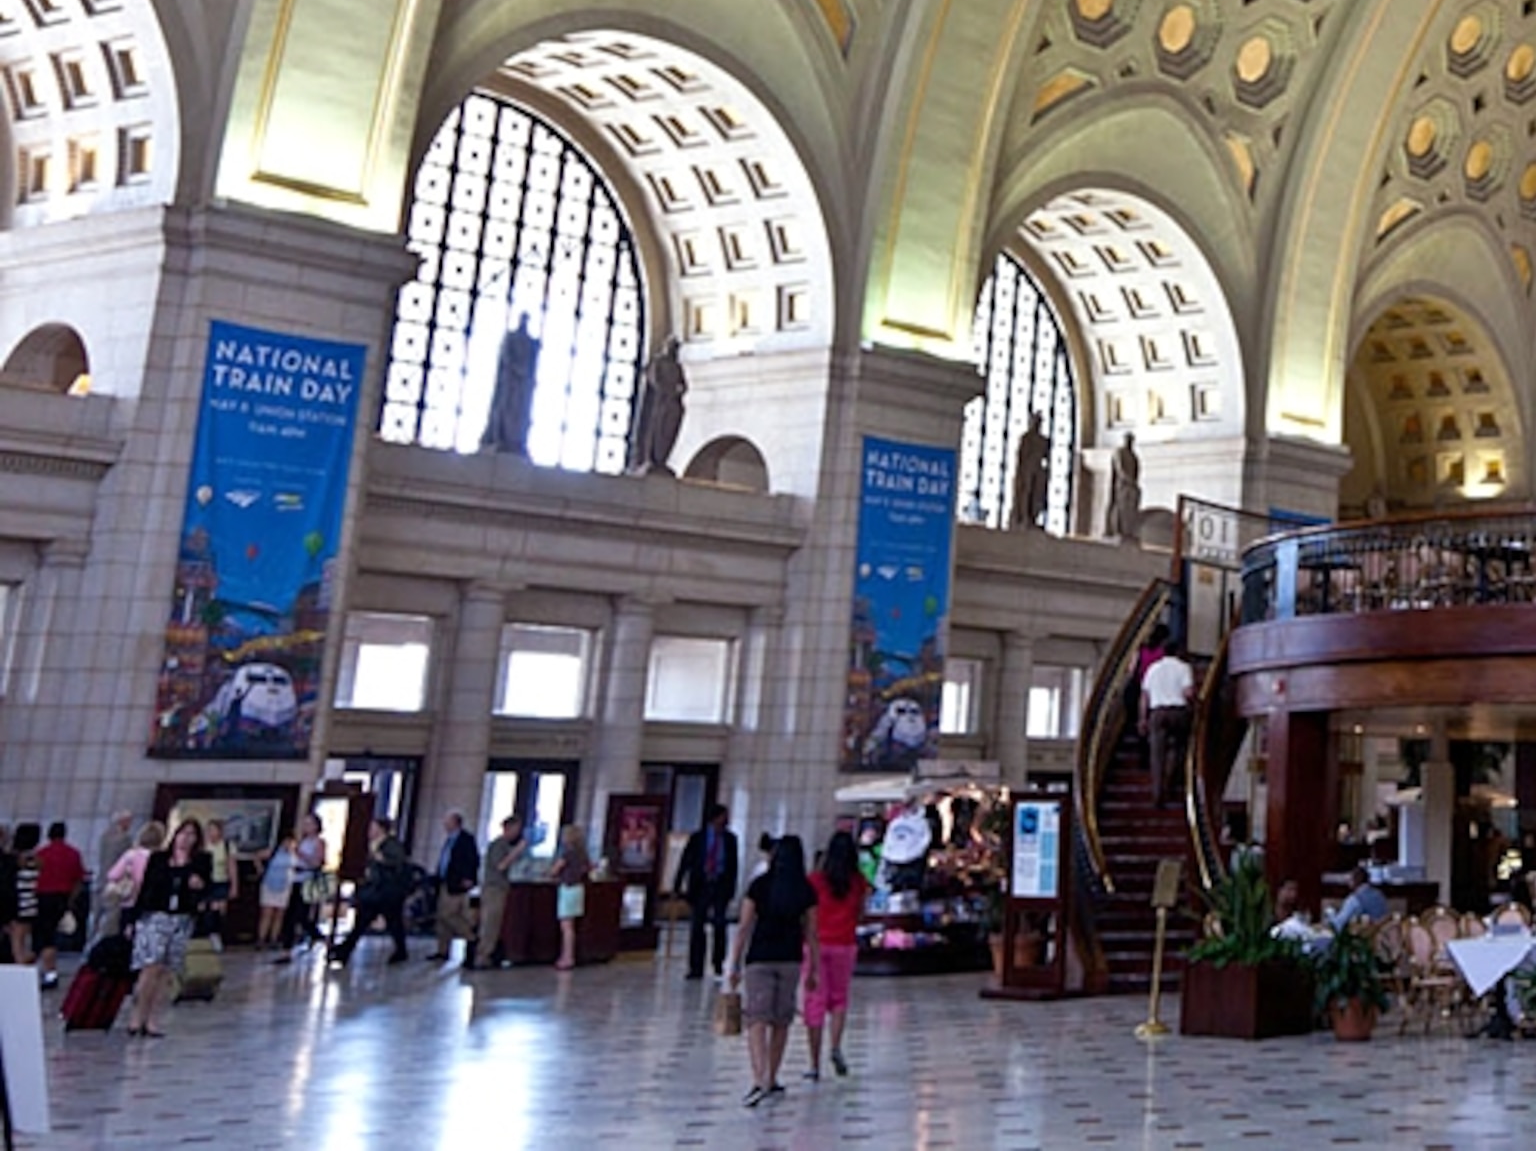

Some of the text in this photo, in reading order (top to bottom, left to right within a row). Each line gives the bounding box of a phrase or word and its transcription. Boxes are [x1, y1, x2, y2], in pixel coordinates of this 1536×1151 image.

[215, 340, 353, 380] NATIONAL
[213, 364, 352, 405] TRAIN DAY
[867, 449, 949, 478] NATIONAL
[867, 469, 949, 497] TRAIN DAY
